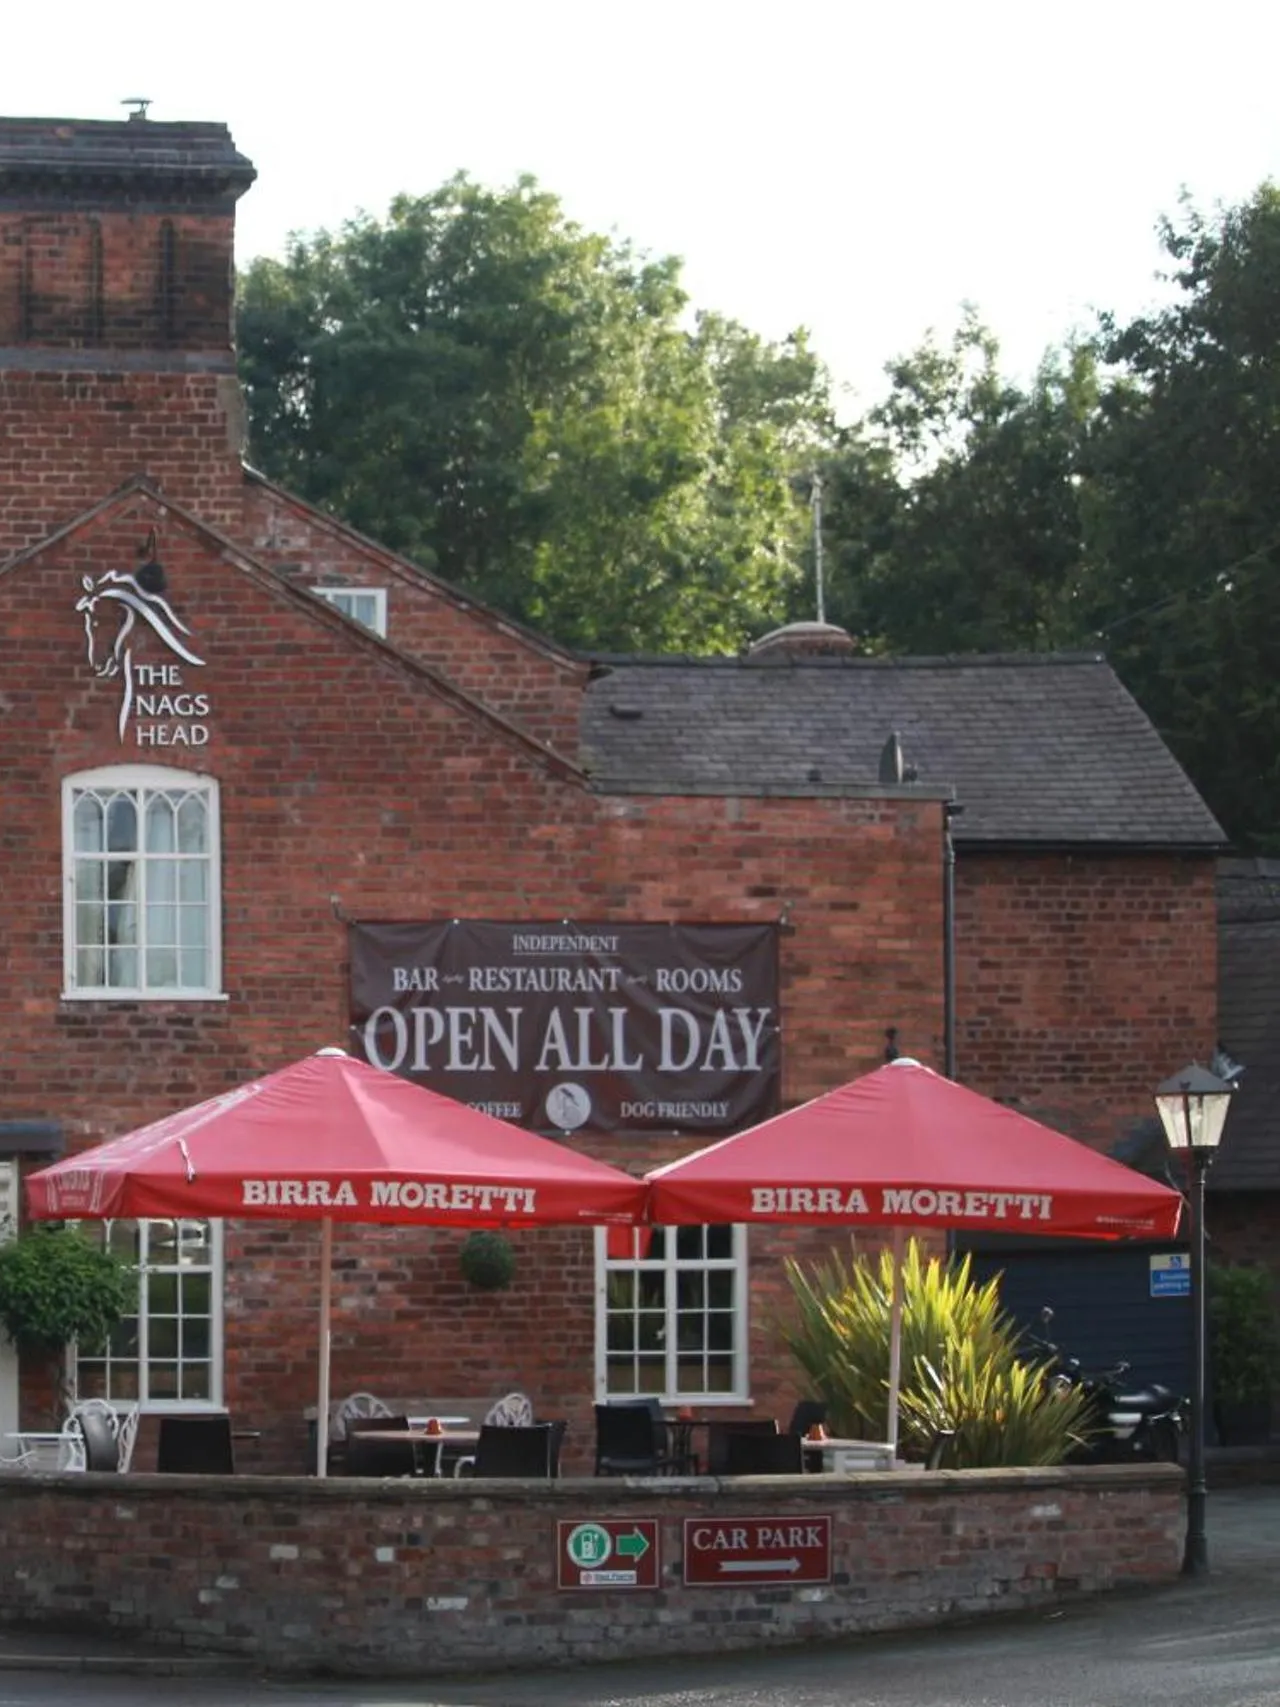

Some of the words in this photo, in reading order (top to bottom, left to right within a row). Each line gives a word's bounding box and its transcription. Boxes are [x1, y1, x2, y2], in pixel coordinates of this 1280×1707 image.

[134, 665, 182, 686] THE
[136, 694, 209, 716] NAGS
[137, 724, 209, 746] HEAD
[512, 933, 619, 953] INDEPENDENT
[393, 967, 440, 992] BAR
[468, 967, 622, 992] RESTAURANT
[656, 967, 743, 993] ROOMS
[364, 1006, 523, 1072] OPEN
[534, 1006, 644, 1072] ALL
[656, 1006, 771, 1072] DAY
[620, 1101, 656, 1118] DOG
[658, 1101, 730, 1118] FRIENDLY
[242, 1180, 358, 1206] BIRRA
[370, 1181, 536, 1213] MORETTI
[751, 1188, 868, 1214] BIRRA
[881, 1189, 1053, 1219] MORETTI
[693, 1528, 748, 1551] CAR
[757, 1526, 823, 1549] PARK
